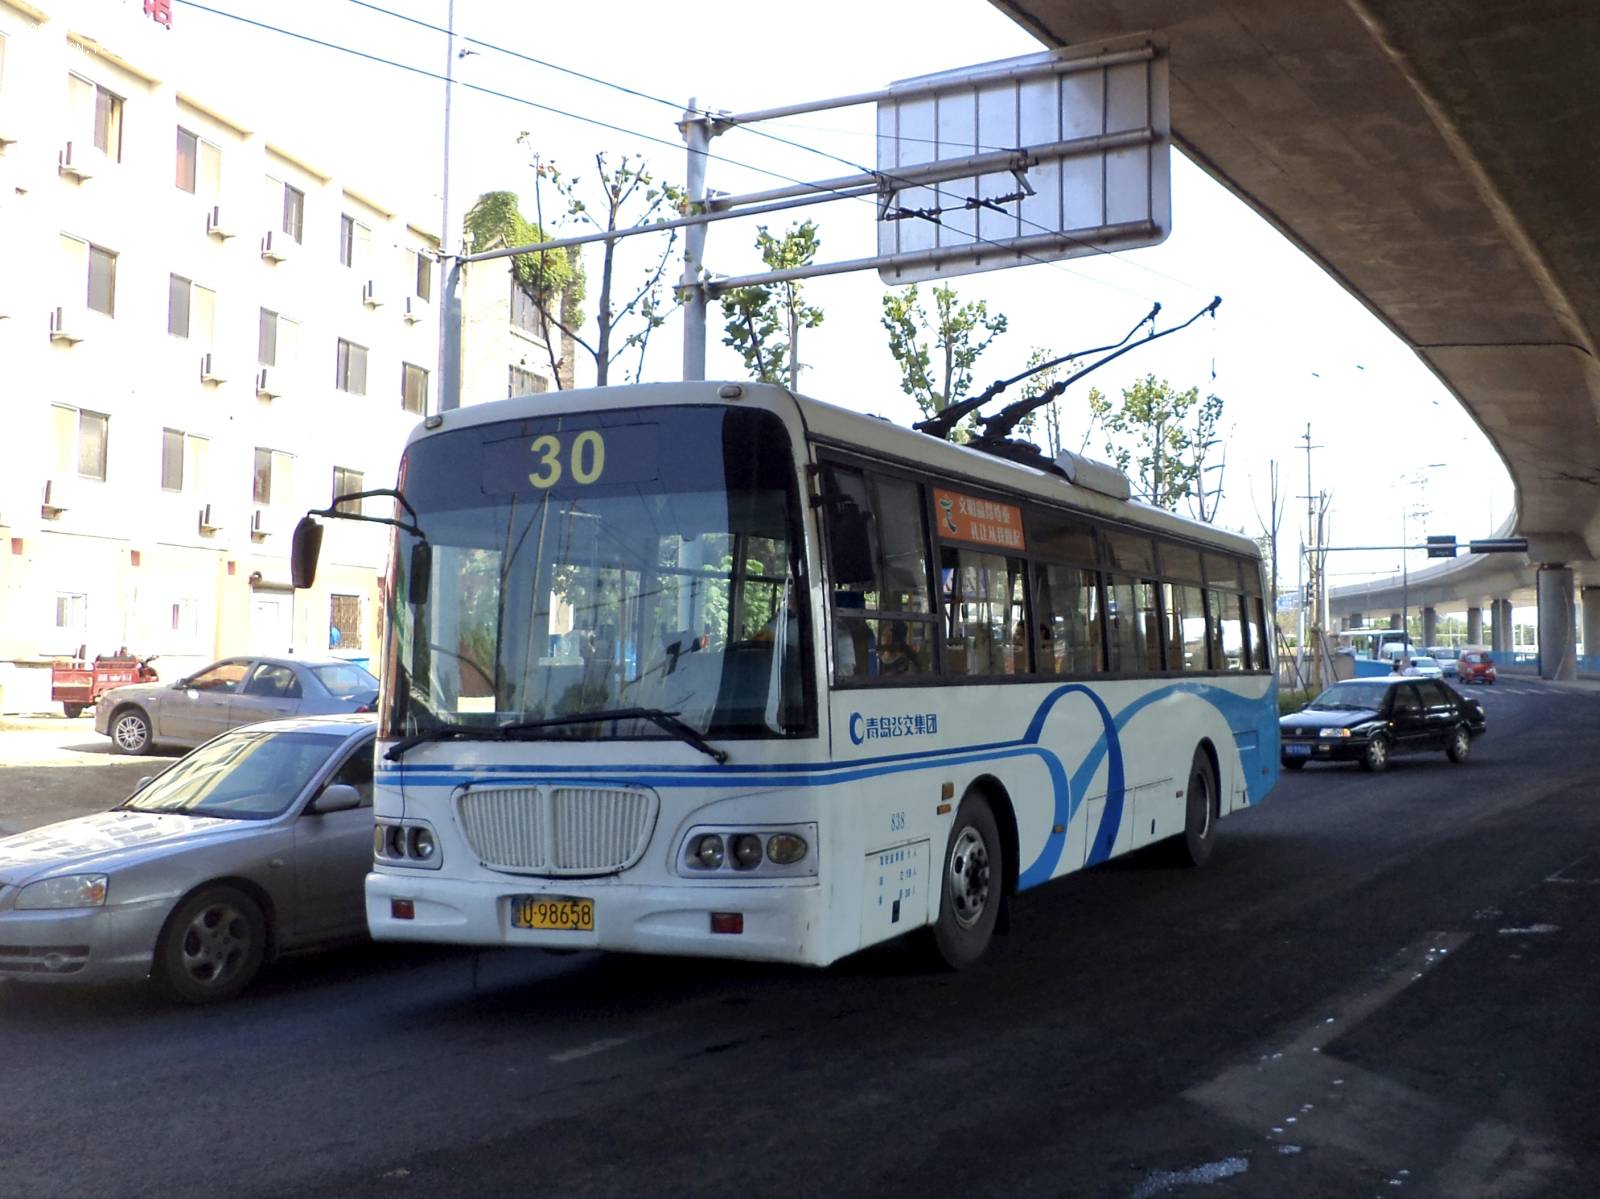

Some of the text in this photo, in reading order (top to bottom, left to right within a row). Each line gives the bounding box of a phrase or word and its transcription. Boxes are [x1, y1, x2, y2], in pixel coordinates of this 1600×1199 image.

[528, 430, 605, 489] 30
[865, 713, 938, 740] 青岛公交集团
